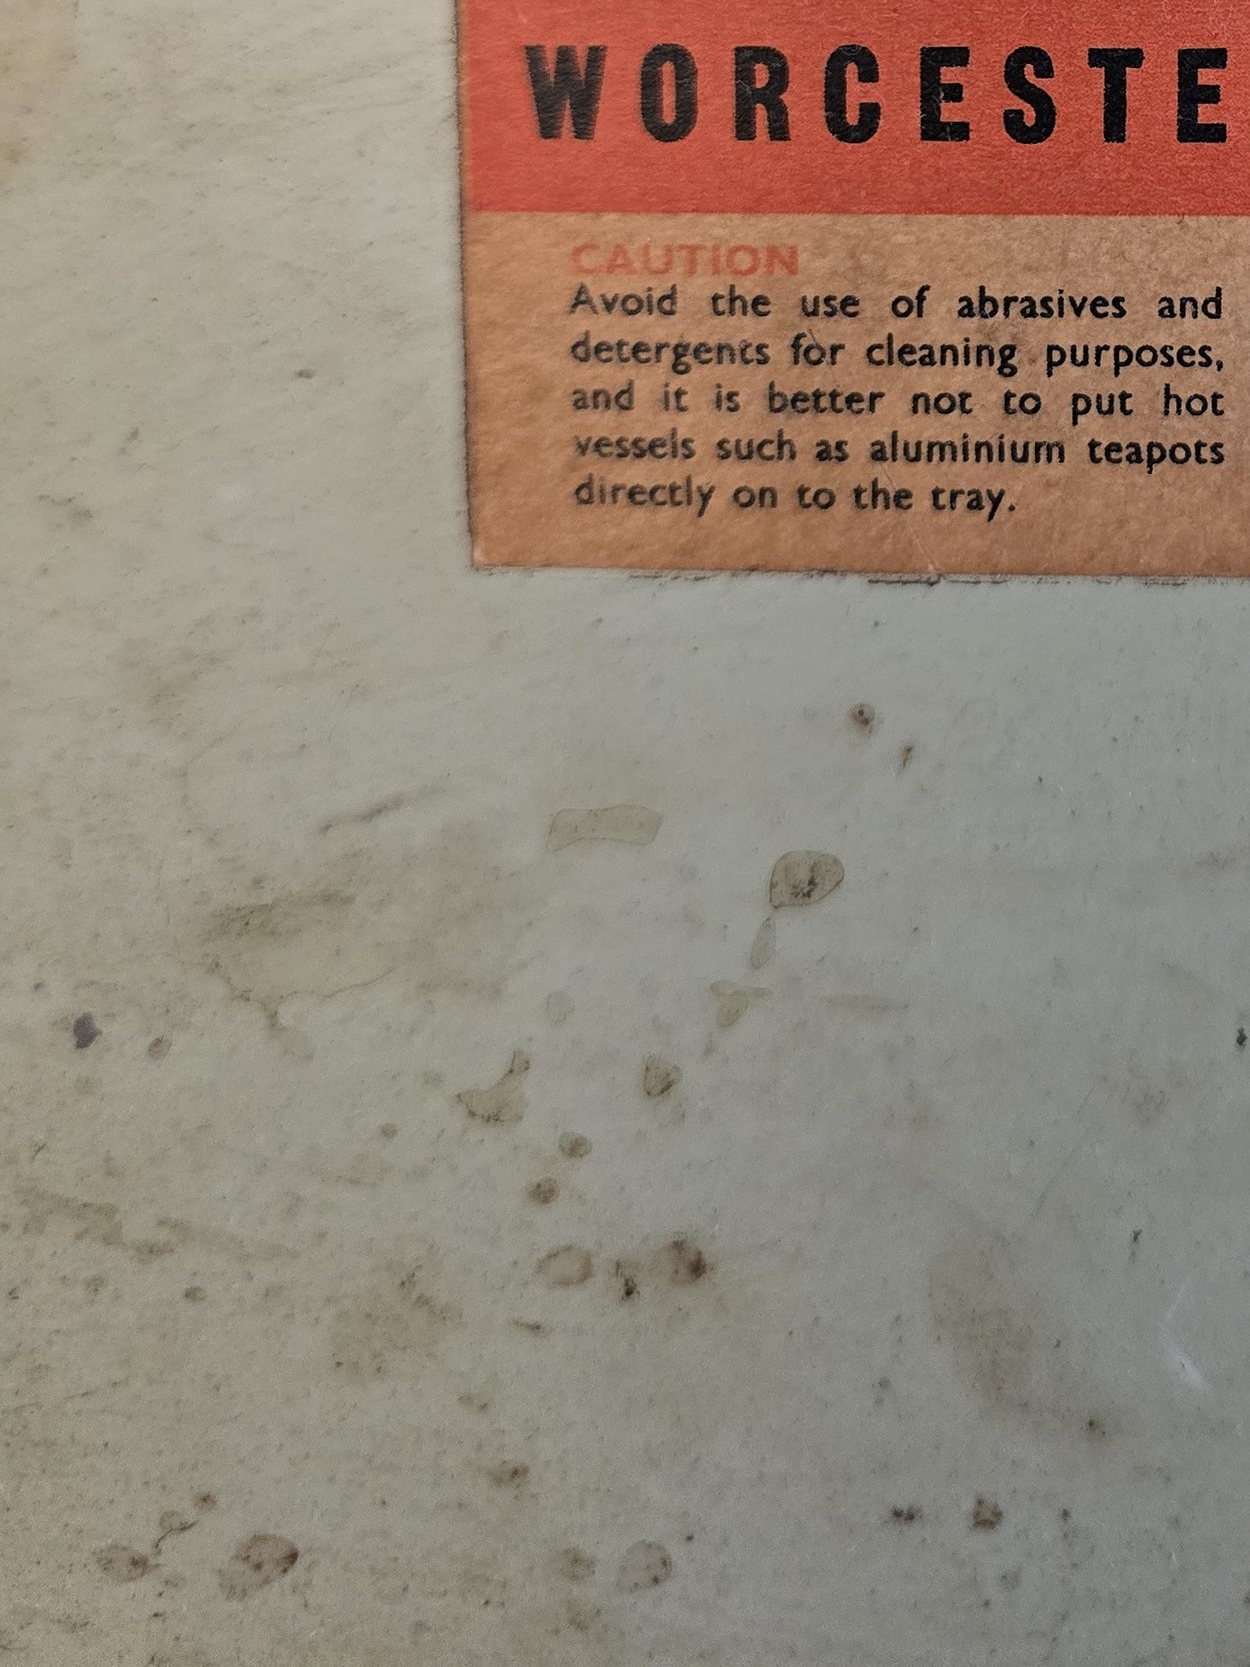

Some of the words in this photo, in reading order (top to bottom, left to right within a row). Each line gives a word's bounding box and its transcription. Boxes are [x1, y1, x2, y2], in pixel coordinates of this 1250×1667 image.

[572, 244, 799, 276] CAUTION
[569, 283, 678, 316] Avoid
[711, 285, 771, 317] the
[801, 294, 860, 317] use
[891, 286, 930, 318] of
[957, 287, 1126, 319] abrasives
[1157, 287, 1222, 319] and
[570, 332, 771, 375] detergents
[791, 334, 845, 366] for
[866, 334, 1017, 376] cleaning
[1046, 339, 1223, 376] purposes,
[572, 379, 635, 412] and
[661, 383, 689, 412] it
[715, 384, 740, 412] is
[769, 381, 884, 413] better
[911, 388, 972, 414] not
[1002, 388, 1041, 415] to
[1070, 389, 1133, 424] put
[1164, 384, 1223, 416] hot
[575, 428, 695, 459] vessels
[716, 429, 795, 461] such
[815, 439, 849, 462] as
[870, 432, 1065, 464] aluminium
[1087, 437, 1225, 474] teapots
[574, 476, 714, 517] directly
[732, 486, 777, 507] on
[797, 483, 835, 509] to
[853, 478, 913, 509] the
[931, 484, 1015, 520] tray.
